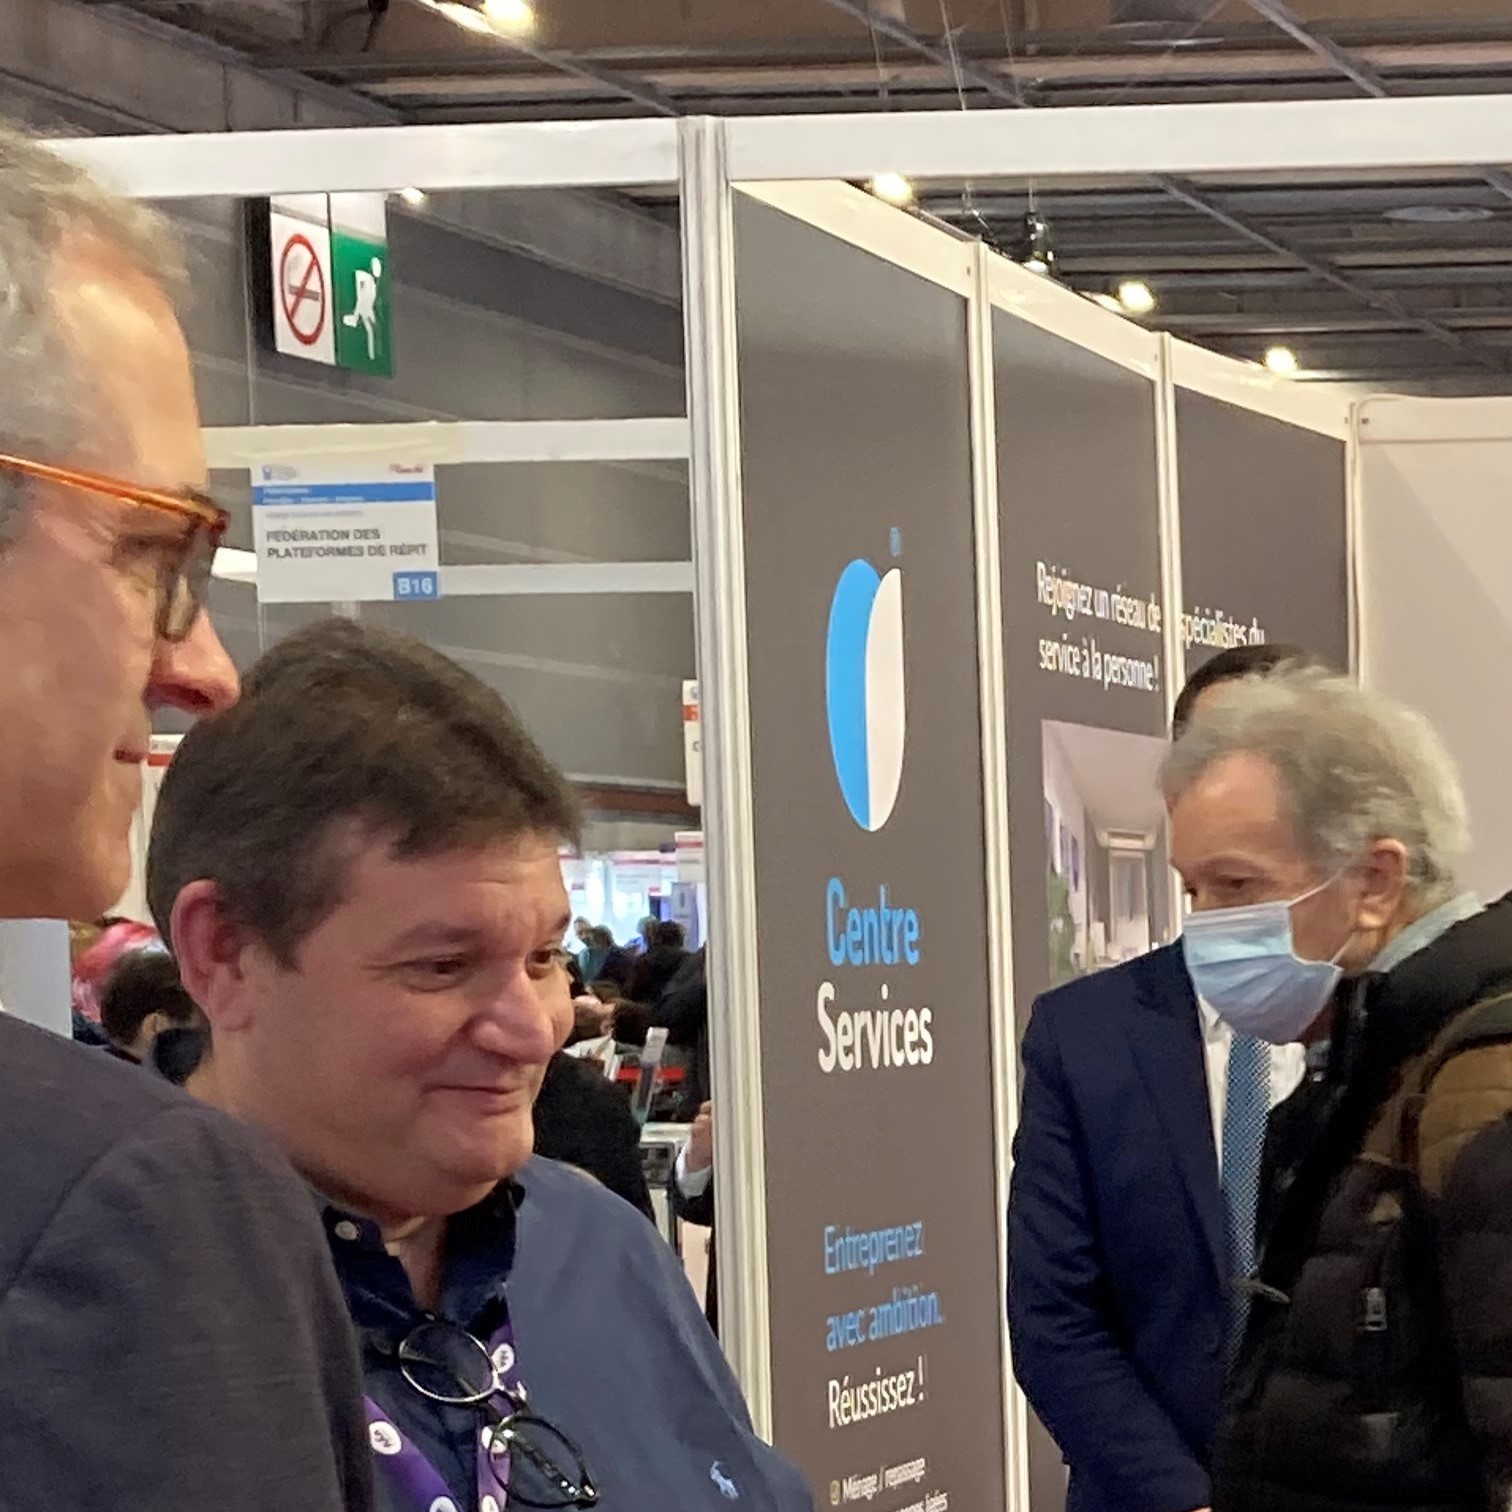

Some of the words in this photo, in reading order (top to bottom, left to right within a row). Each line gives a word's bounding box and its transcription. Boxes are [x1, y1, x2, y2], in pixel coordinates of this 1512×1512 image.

[267, 546, 364, 559] PLATEFORMES
[368, 545, 387, 556] DE
[354, 529, 380, 540] DES
[398, 577, 433, 595] B16
[1037, 561, 1092, 620] Rejoignez
[1095, 589, 1109, 619] un
[1111, 584, 1146, 629] réseau
[1148, 593, 1161, 632] de
[1039, 633, 1081, 676] service
[1091, 638, 1102, 680] la
[826, 876, 920, 967] Centre
[817, 981, 933, 1073] Services
[824, 1221, 923, 1276] Entreprenez
[827, 1309, 865, 1351] avec
[869, 1284, 943, 1341] ambition.
[829, 1366, 915, 1429] Réussissez
